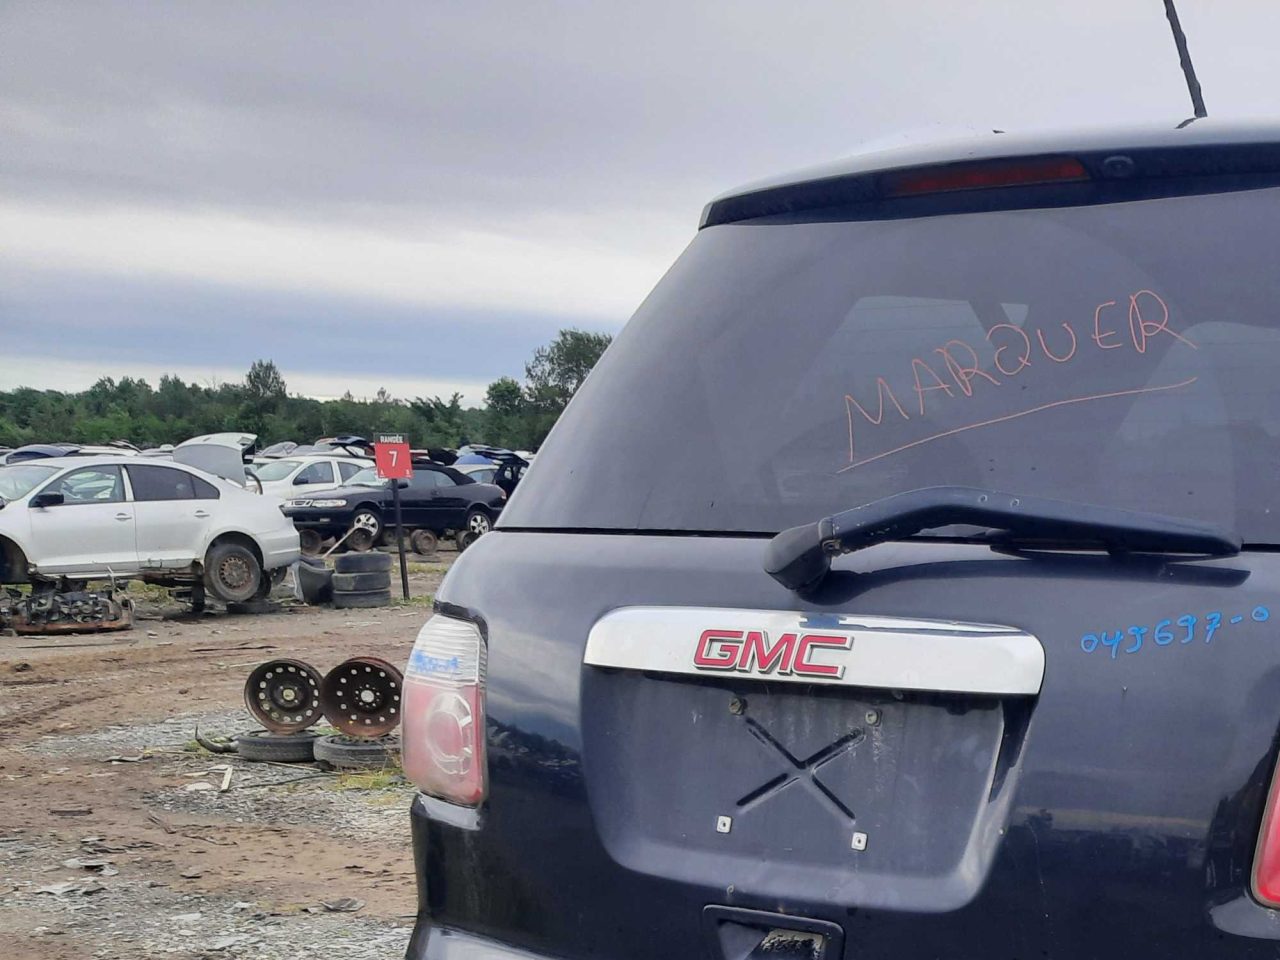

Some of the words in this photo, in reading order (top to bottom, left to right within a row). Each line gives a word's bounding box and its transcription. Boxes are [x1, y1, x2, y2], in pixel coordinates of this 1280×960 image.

[845, 289, 1198, 462] MARQUER
[388, 450, 398, 467] 7
[693, 629, 855, 680] GMC
